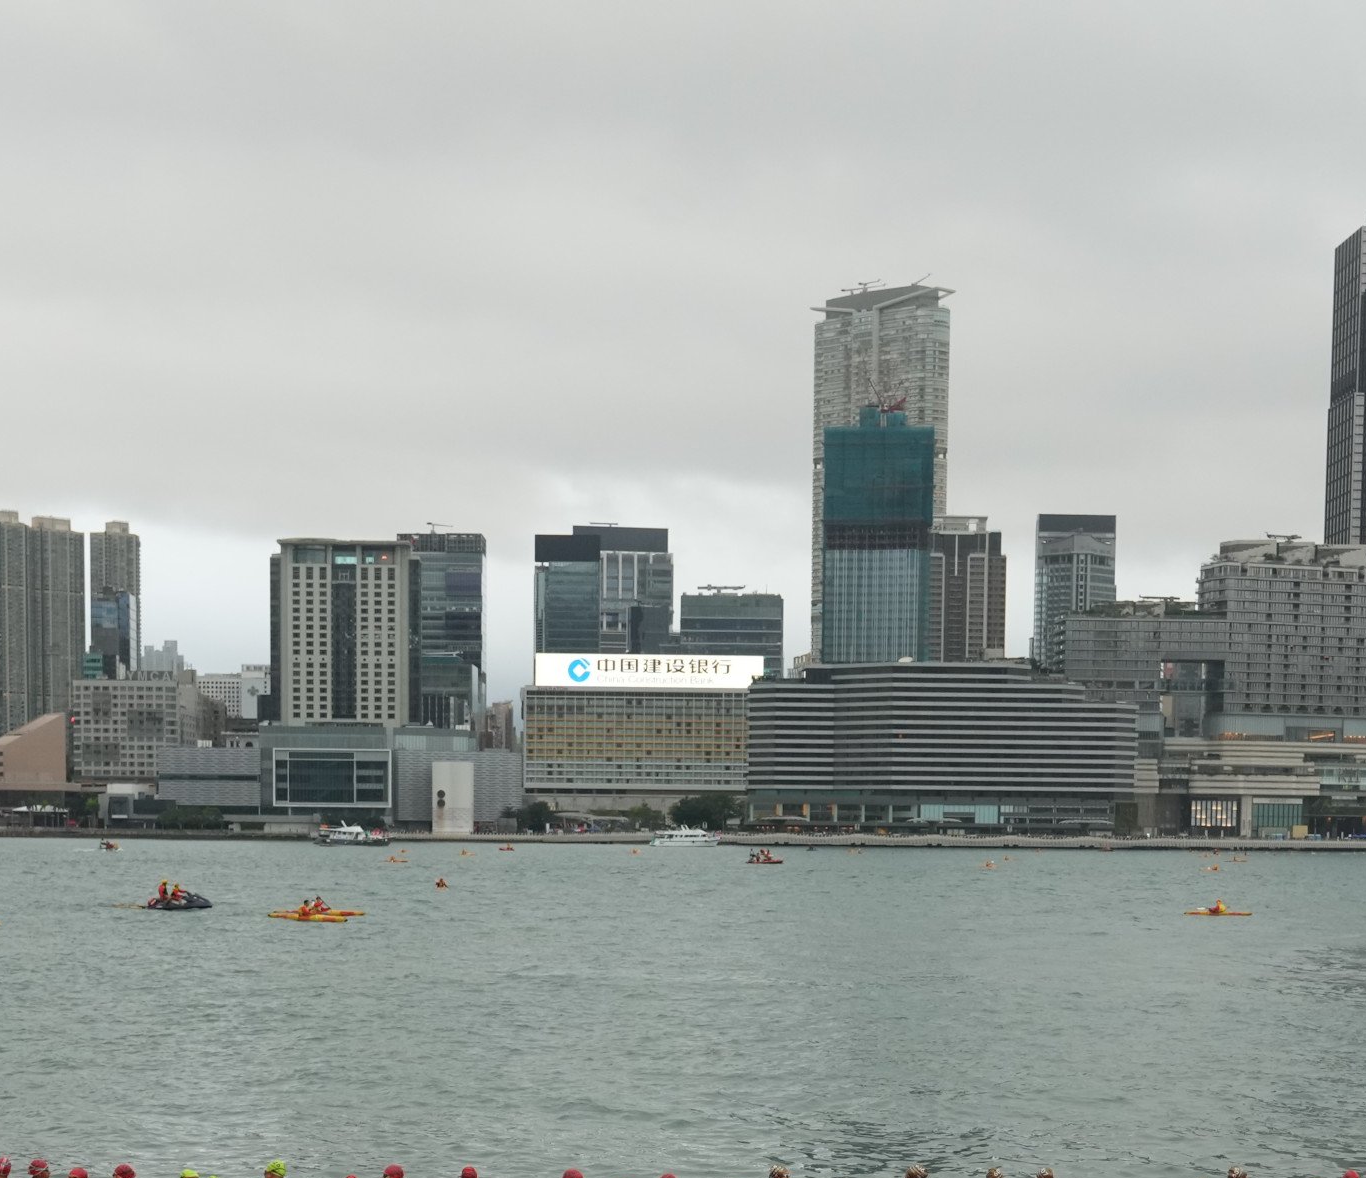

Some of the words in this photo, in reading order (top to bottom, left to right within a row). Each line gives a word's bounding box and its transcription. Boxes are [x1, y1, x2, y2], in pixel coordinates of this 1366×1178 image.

[597, 658, 732, 675] 中国建设银行
[126, 671, 171, 682] YMCA
